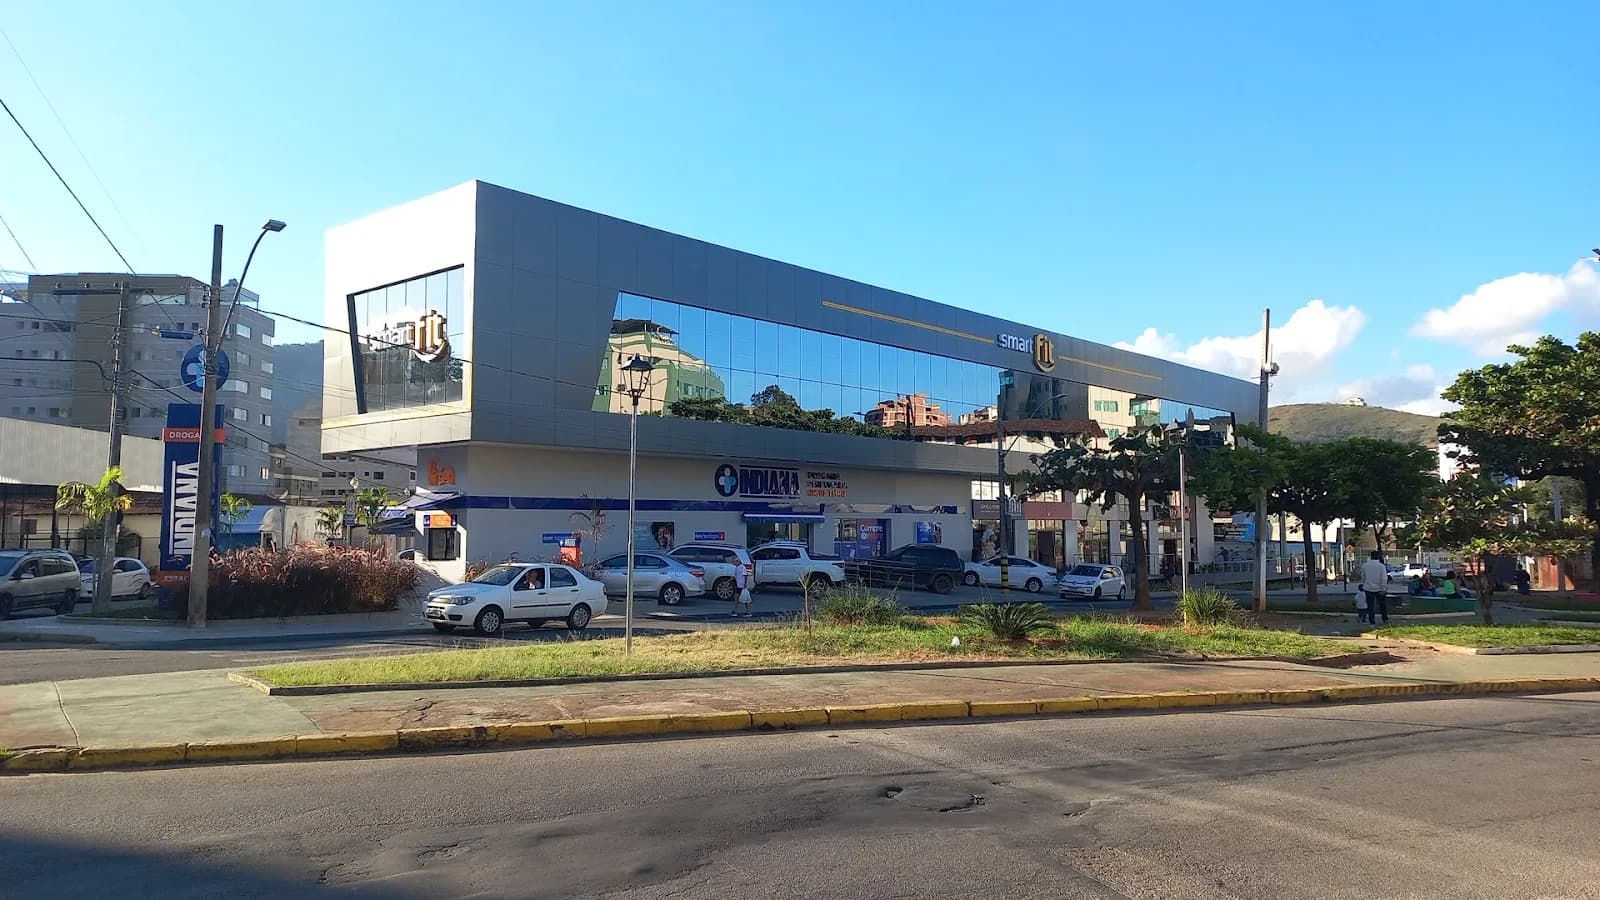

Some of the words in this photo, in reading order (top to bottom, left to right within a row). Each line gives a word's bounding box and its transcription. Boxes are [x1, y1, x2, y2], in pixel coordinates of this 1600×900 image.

[414, 309, 450, 361] fit
[999, 333, 1034, 354] smart
[1034, 333, 1056, 371] fit
[169, 431, 201, 440] DROGA
[740, 469, 800, 496] INDIANA
[173, 462, 199, 556] INDIANA
